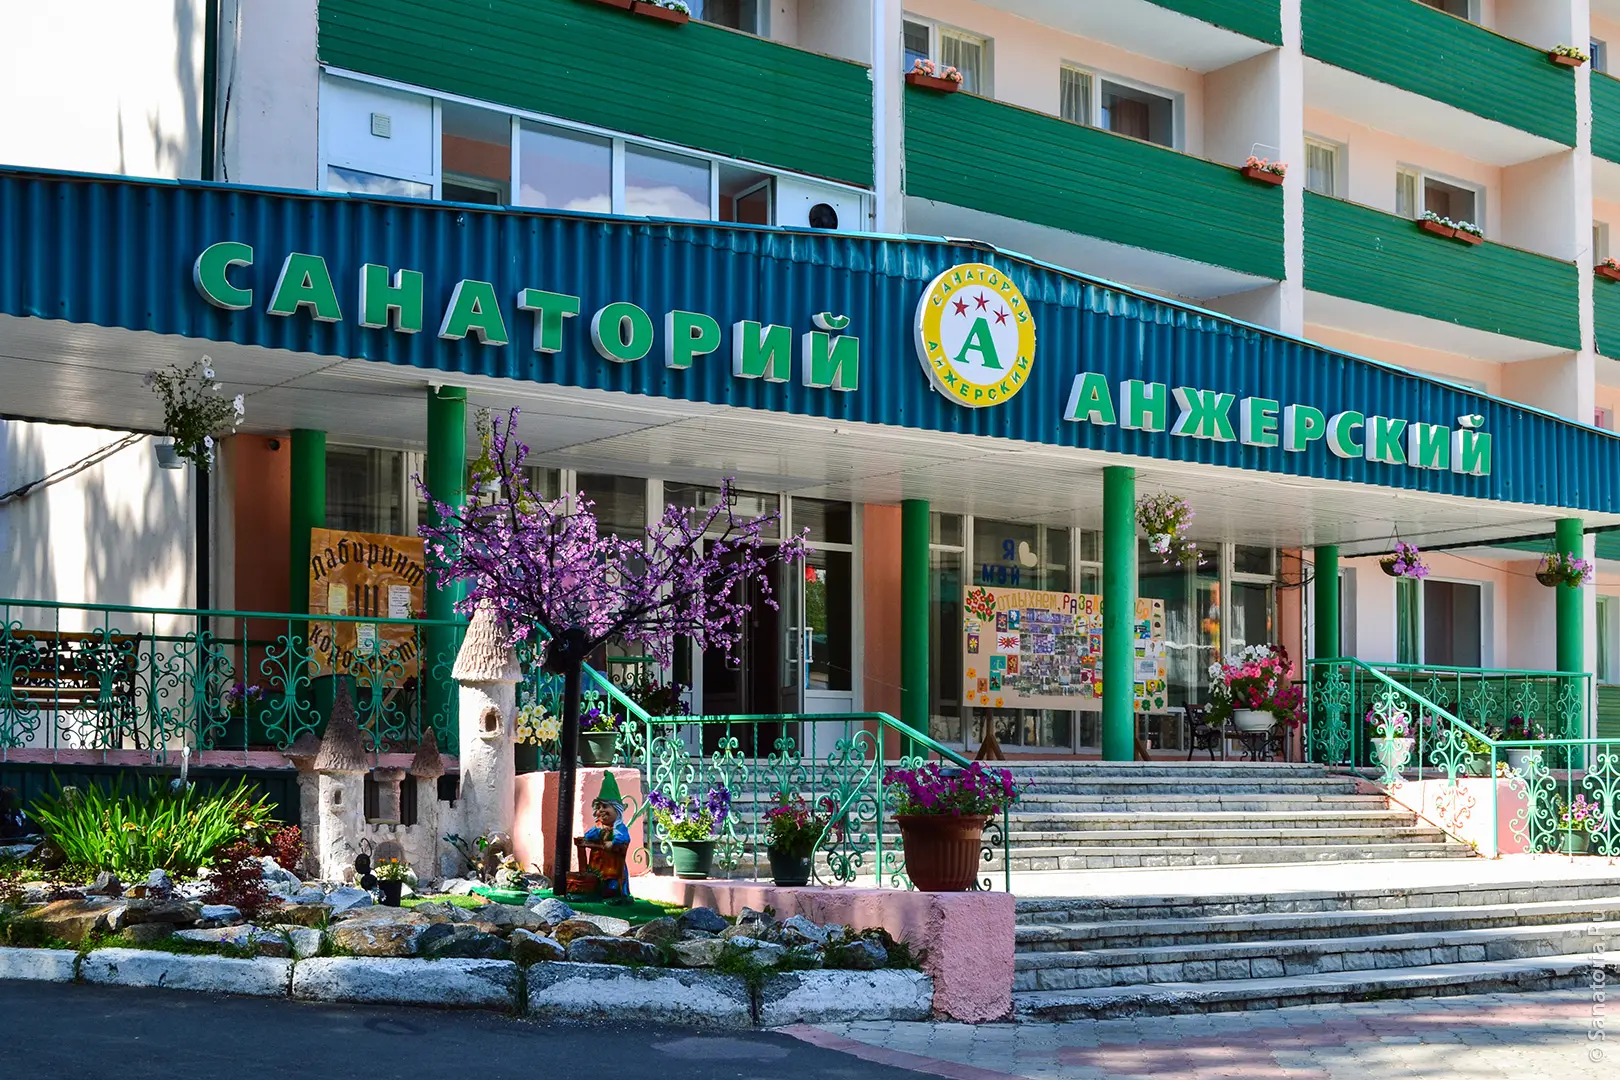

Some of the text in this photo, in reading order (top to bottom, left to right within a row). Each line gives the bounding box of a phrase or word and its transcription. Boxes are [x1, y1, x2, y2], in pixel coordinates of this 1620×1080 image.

[193, 241, 859, 391] САНАТОРИЙ
[933, 269, 1029, 324] САНАТОРИЙ
[928, 340, 1029, 400] АНЖЕРСКИЙ
[953, 316, 1004, 370] А
[1063, 371, 1492, 476] АНЖЕРСКИЙ
[1002, 538, 1015, 561] Я
